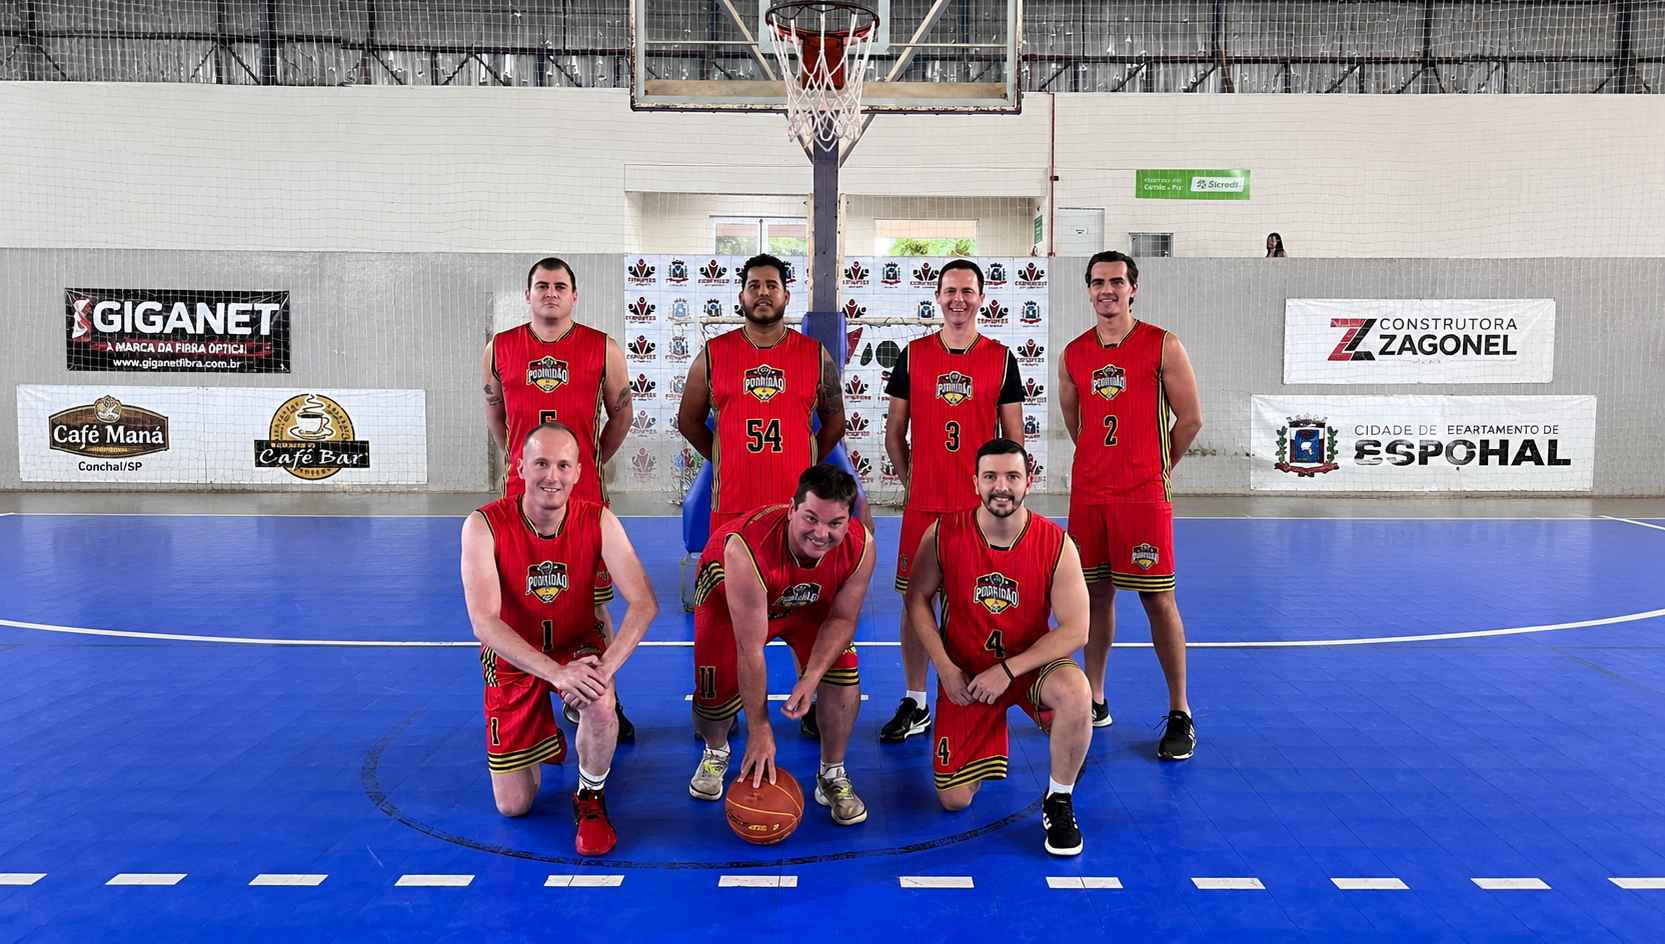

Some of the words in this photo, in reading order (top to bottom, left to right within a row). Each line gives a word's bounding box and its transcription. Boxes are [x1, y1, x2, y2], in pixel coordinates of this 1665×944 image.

[93, 300, 280, 335] GIGANET
[1379, 317, 1518, 331] CONSTRUTORA
[115, 342, 155, 353] MARCA
[157, 342, 172, 353] DA
[1378, 334, 1518, 356] ZAGONEL
[113, 357, 242, 369] www.giganetfibra.com.br
[53, 424, 99, 450] Café
[105, 424, 164, 444] Maná
[746, 418, 783, 454] 54
[945, 420, 961, 452] 3
[1103, 415, 1118, 447] 2
[1354, 424, 1413, 436] CIDADE
[1419, 424, 1438, 436] DE
[1543, 424, 1559, 435] DE
[78, 461, 143, 472] Conchal/SP
[259, 448, 314, 471] Café
[319, 449, 363, 465] Bar
[541, 619, 554, 652] 1
[984, 629, 1005, 659] 4
[699, 666, 717, 699] 11
[490, 716, 500, 747] 1
[937, 736, 951, 766] 4
